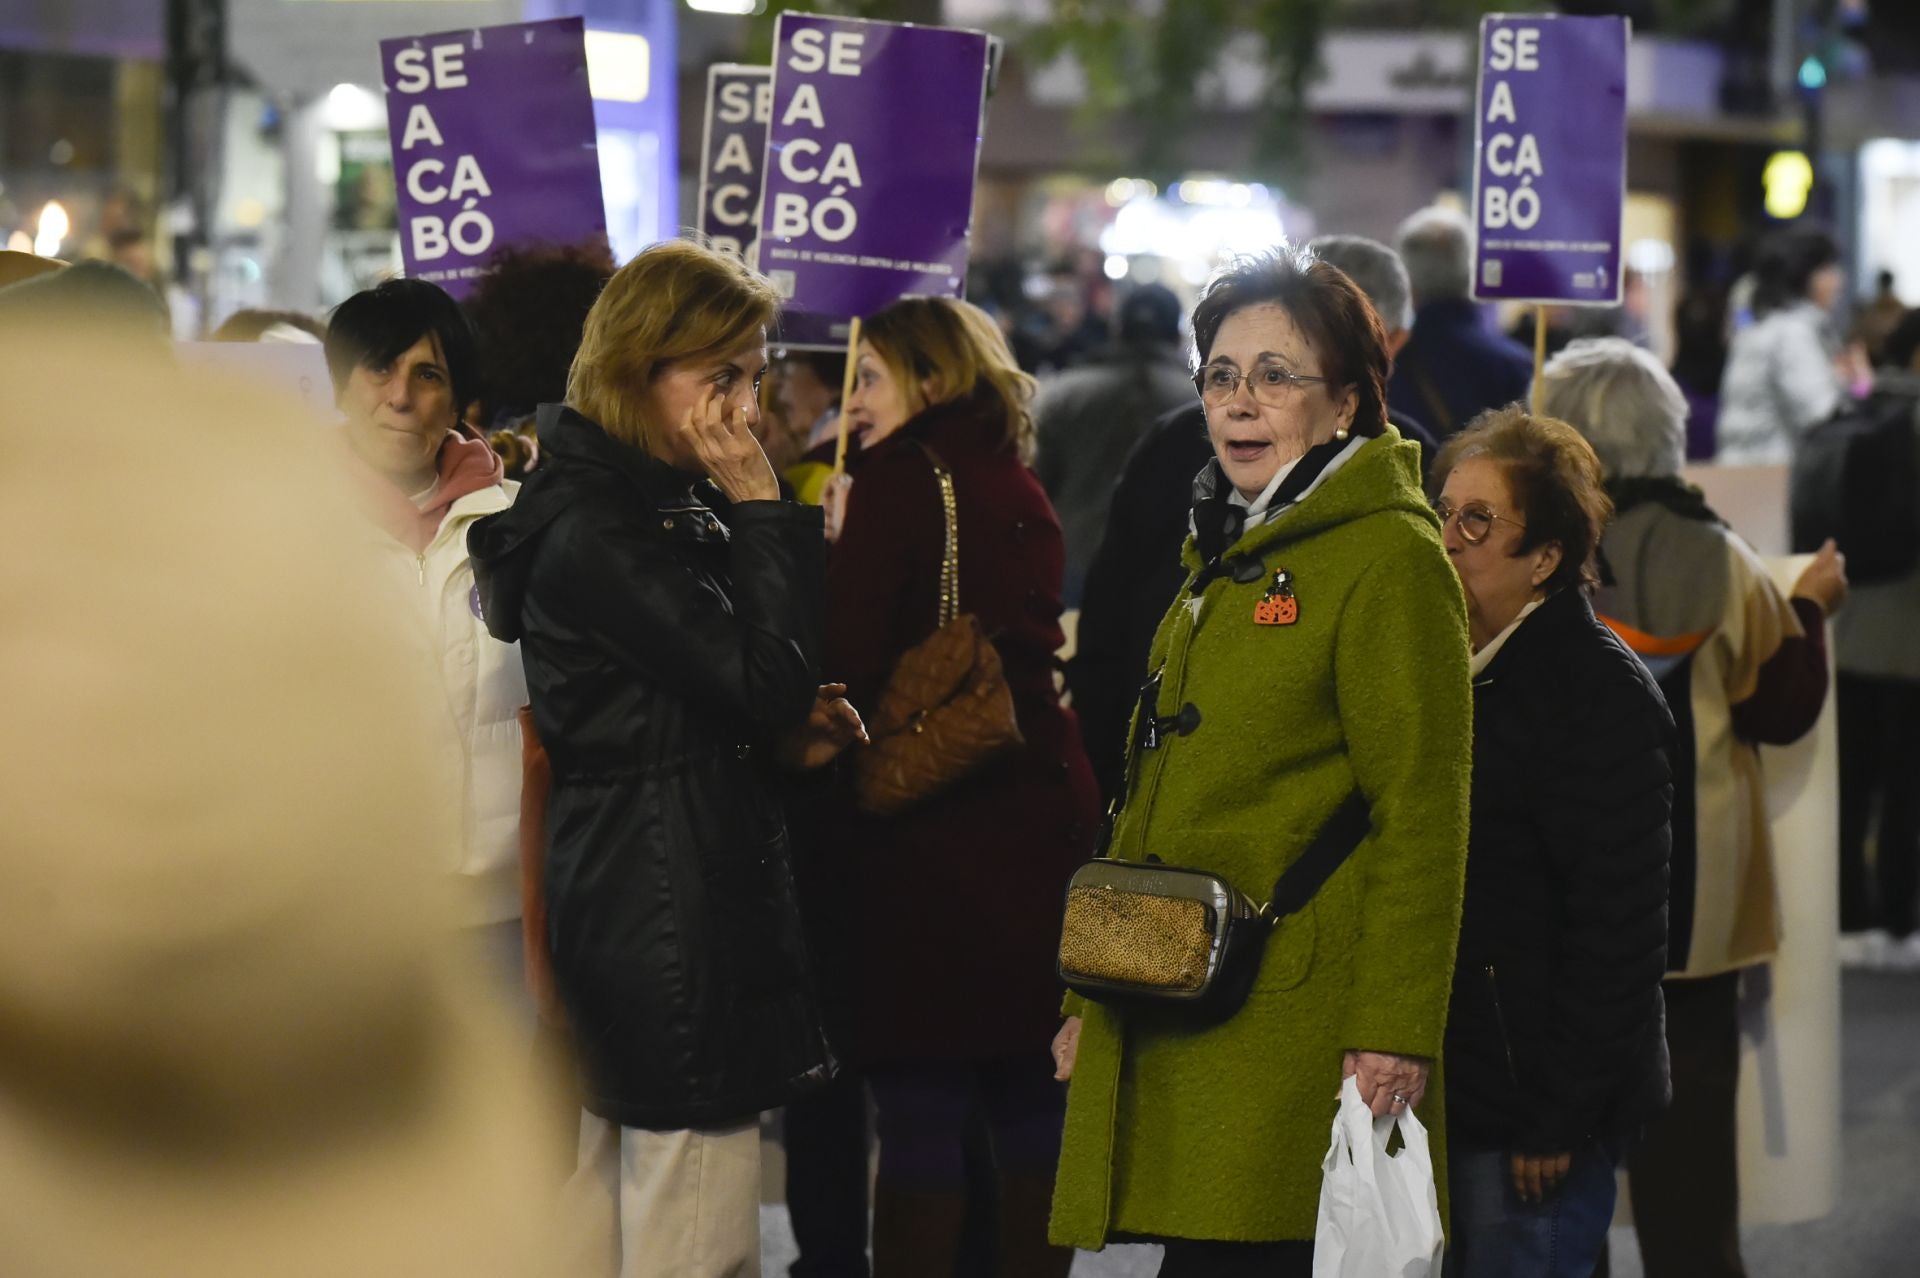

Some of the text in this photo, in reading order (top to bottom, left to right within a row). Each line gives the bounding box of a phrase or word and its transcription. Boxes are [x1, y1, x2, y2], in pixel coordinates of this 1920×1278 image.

[394, 43, 468, 94] SE
[788, 28, 864, 76] SE
[1489, 28, 1541, 71] SE
[782, 83, 825, 128] A
[1486, 80, 1517, 123] A
[402, 104, 444, 150] A
[714, 133, 752, 173] A
[779, 138, 862, 187] CA
[1486, 133, 1543, 177] CA
[406, 154, 492, 204] CA
[1484, 175, 1541, 230] BÓ
[411, 197, 494, 261] BÓ
[773, 184, 857, 242] BÓ
